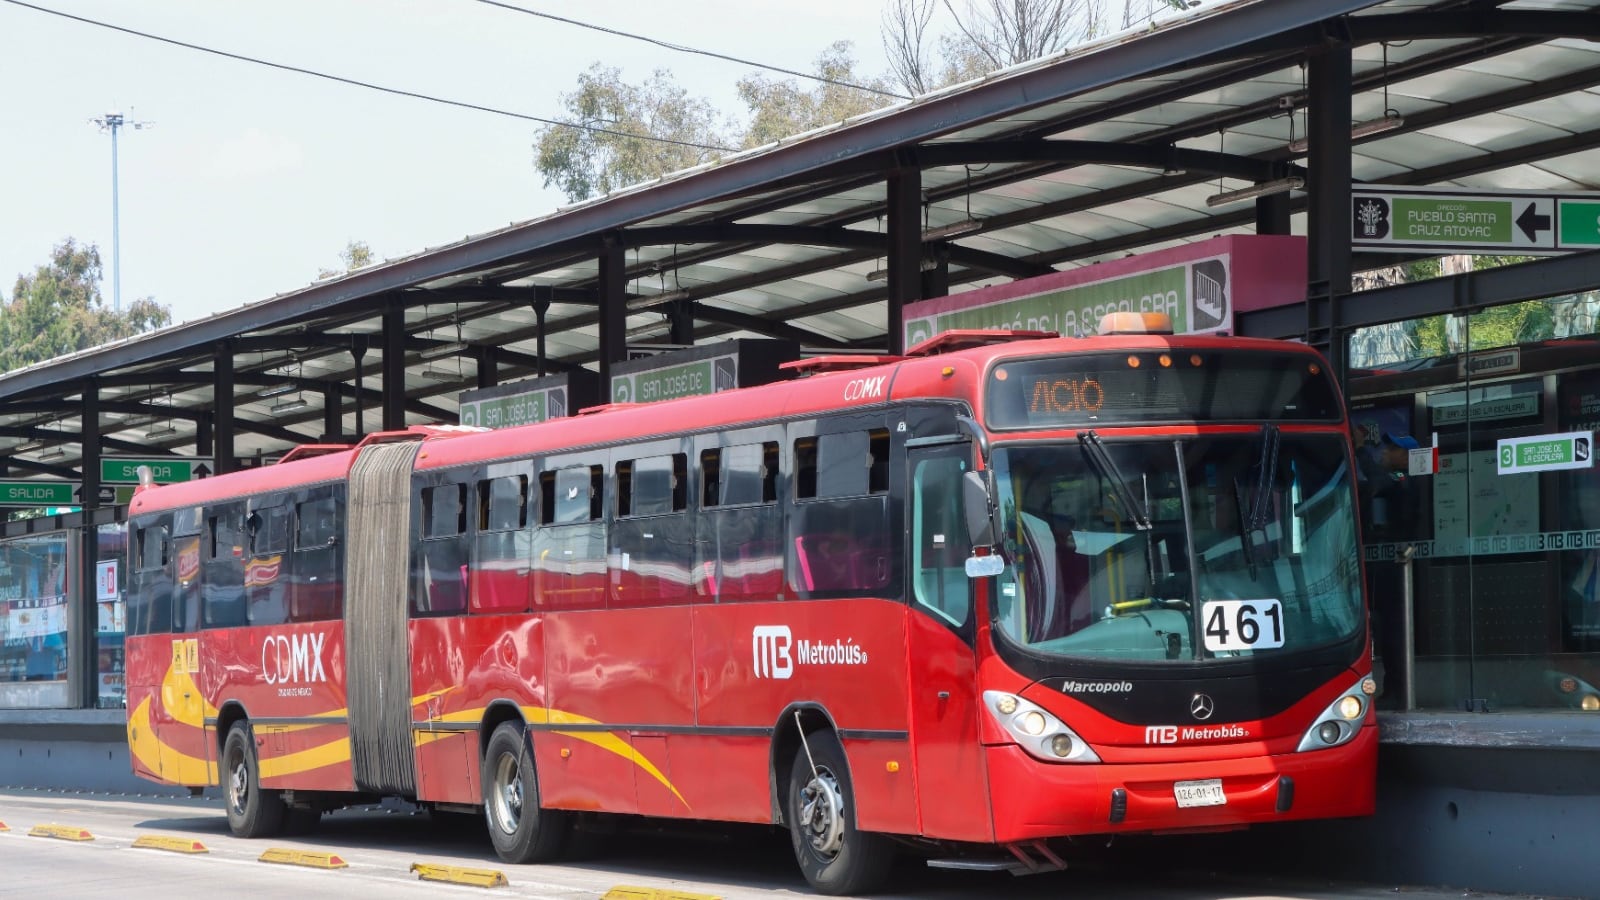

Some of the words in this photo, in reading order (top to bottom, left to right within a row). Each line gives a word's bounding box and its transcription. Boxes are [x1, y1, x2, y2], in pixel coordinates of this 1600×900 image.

[1408, 210, 1454, 223] PUEBLO
[1458, 212, 1497, 224] SANTA
[1409, 224, 1441, 236] CRUZ
[1444, 225, 1491, 237] ATOYAC
[642, 379, 661, 399] SAN
[663, 369, 688, 395] JOSÉ
[689, 370, 703, 390] DE
[843, 375, 886, 401] CDMX
[486, 407, 503, 425] SAN
[504, 399, 526, 422] JOSÉ
[527, 400, 539, 418] DE
[1502, 448, 1512, 465] 3
[1523, 447, 1535, 455] SAN
[1537, 443, 1552, 454] JOSÉ
[1553, 444, 1563, 452] DE
[1524, 456, 1532, 464] LA
[1533, 452, 1564, 463] ESCALERA
[122, 466, 171, 477] SADA
[9, 487, 54, 499] SALIDA
[1205, 603, 1283, 646] 461
[262, 632, 326, 685] CDMX
[1062, 680, 1133, 694] Marcopolo
